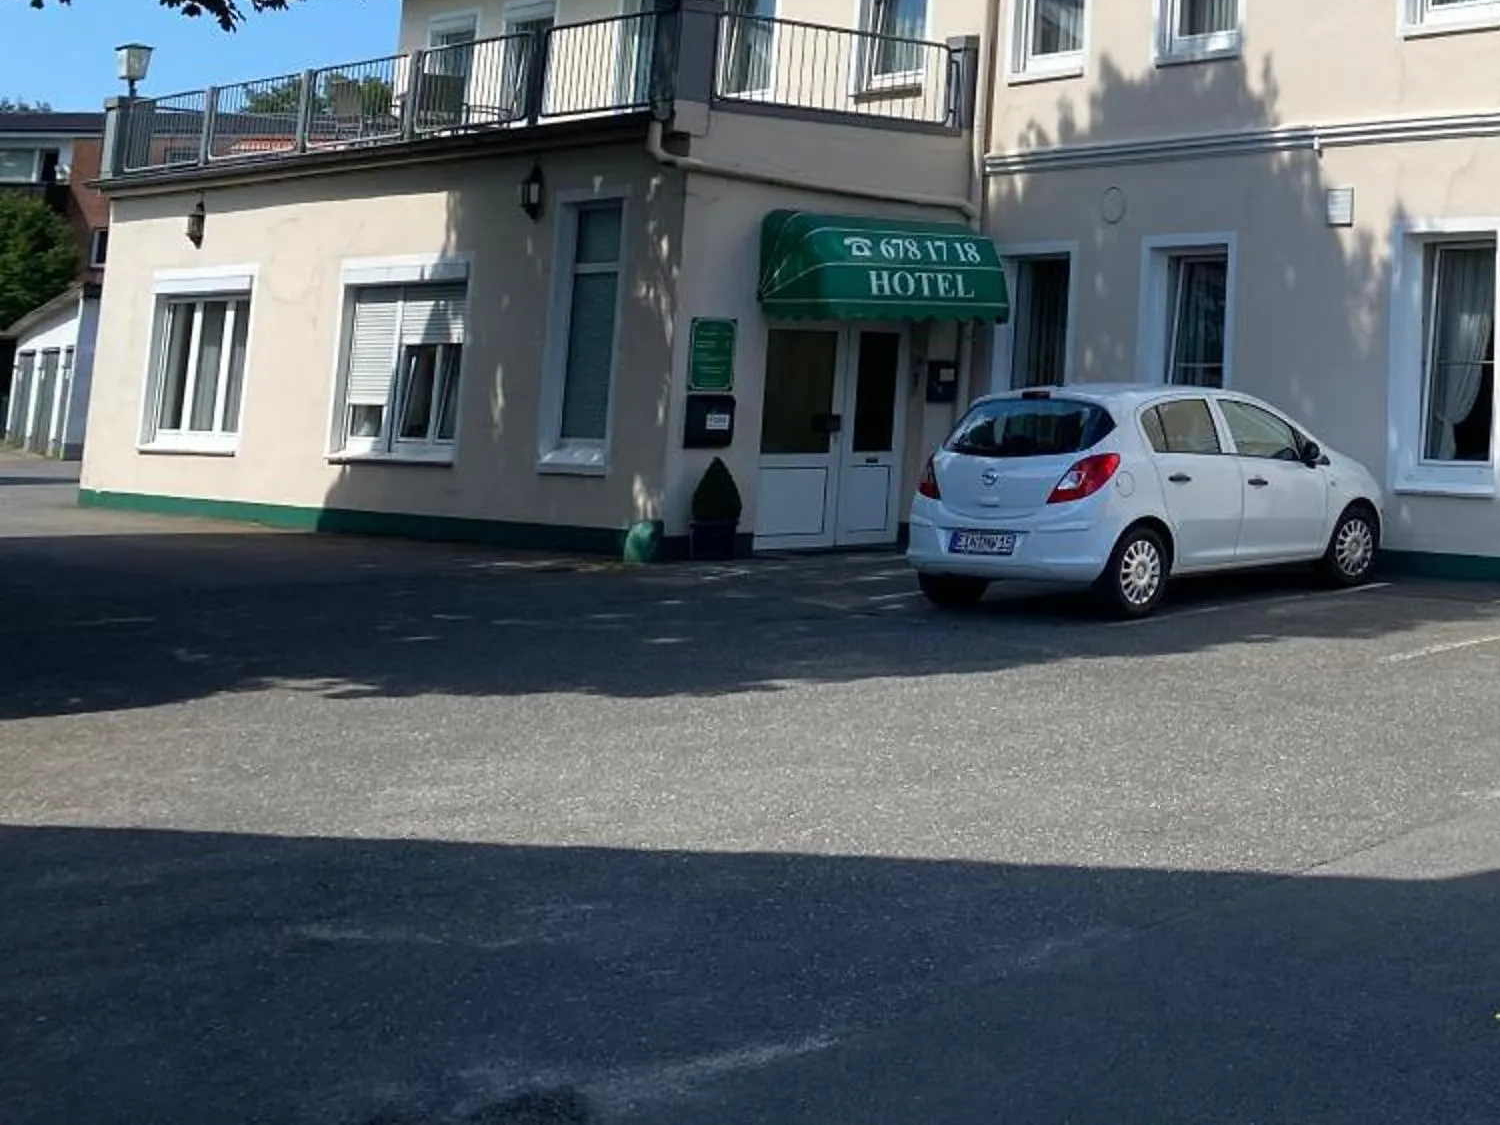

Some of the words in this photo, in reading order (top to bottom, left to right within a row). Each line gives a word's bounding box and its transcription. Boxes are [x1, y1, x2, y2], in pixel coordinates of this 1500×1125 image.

[880, 237, 921, 261] 678
[925, 238, 948, 262] 17
[953, 241, 981, 264] 18
[869, 270, 975, 298] HOTEL
